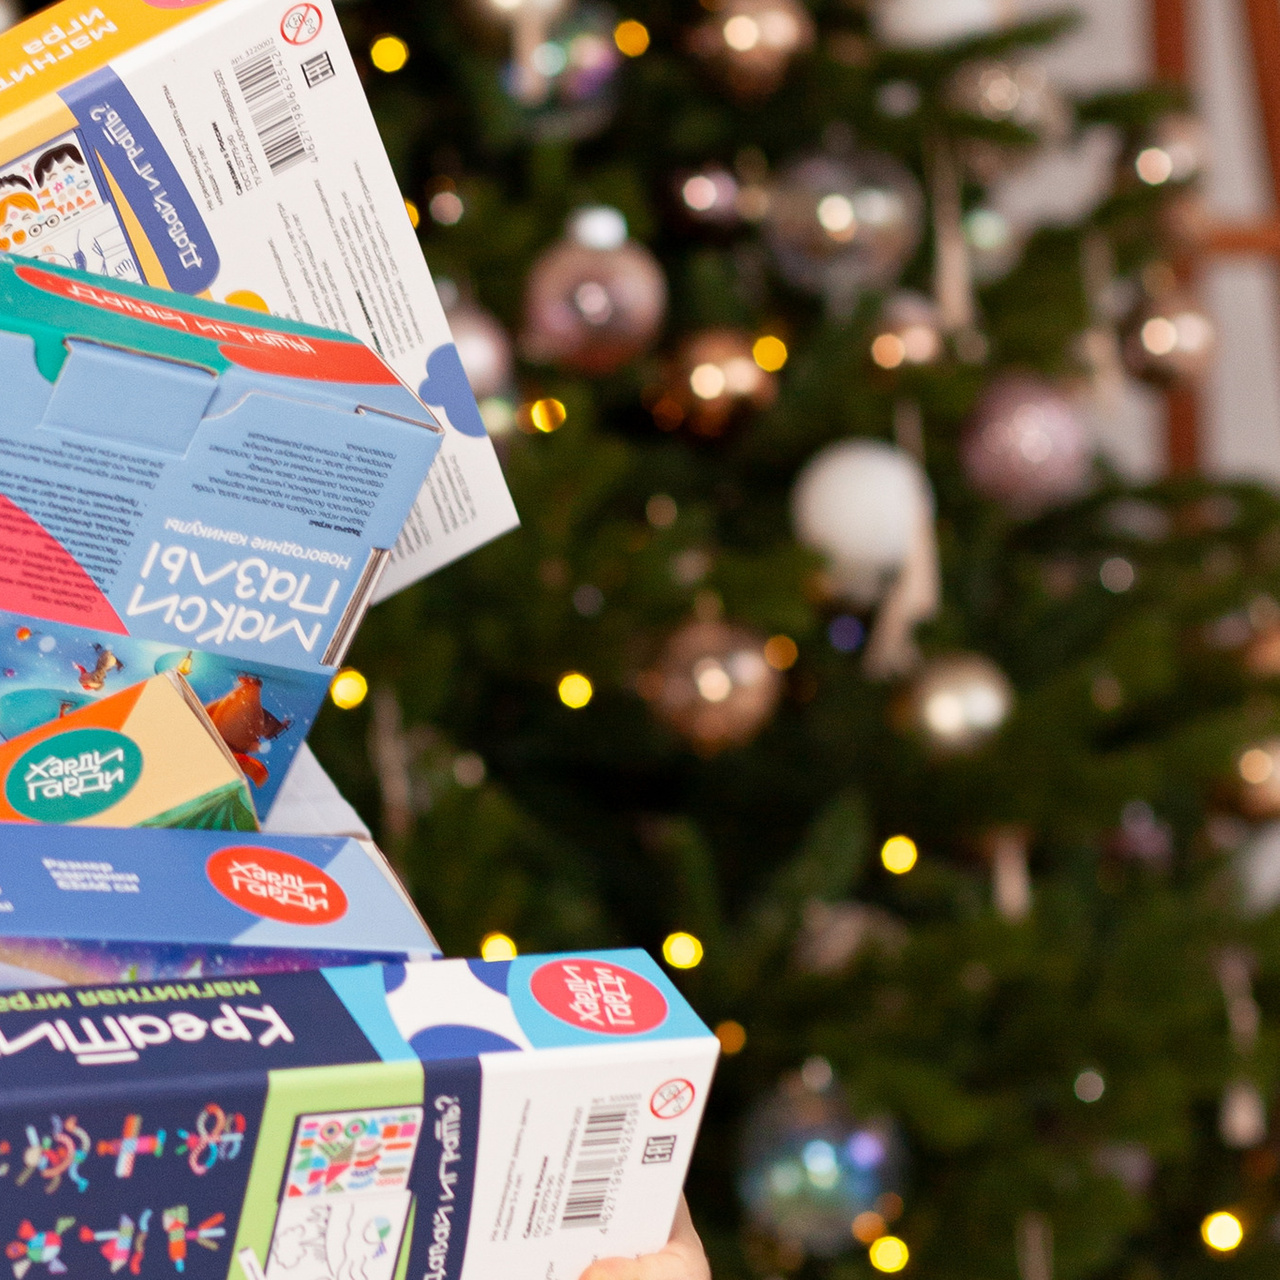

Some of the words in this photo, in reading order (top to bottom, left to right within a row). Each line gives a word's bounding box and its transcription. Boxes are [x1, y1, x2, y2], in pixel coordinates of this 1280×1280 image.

[22, 6, 107, 55] игра
[211, 121, 225, 152] России
[226, 159, 242, 195] Сделано
[164, 517, 248, 545] каникулы
[250, 536, 352, 570] Новогодние
[77, 979, 262, 1007] магнитная
